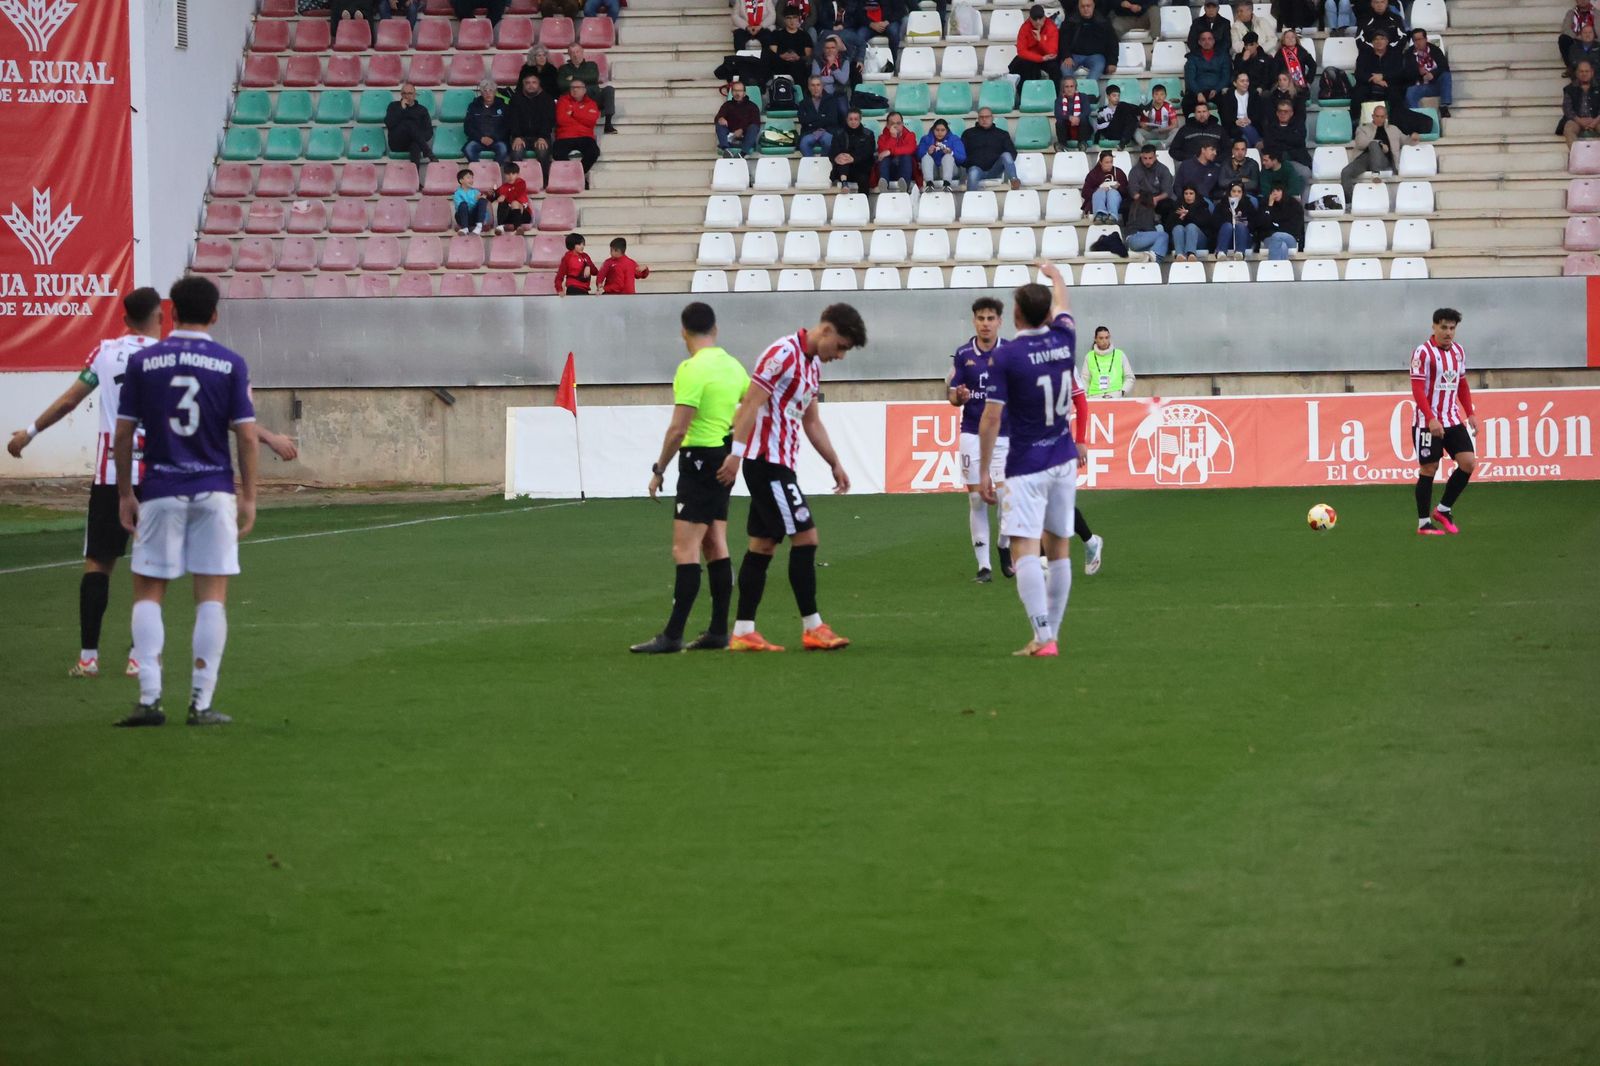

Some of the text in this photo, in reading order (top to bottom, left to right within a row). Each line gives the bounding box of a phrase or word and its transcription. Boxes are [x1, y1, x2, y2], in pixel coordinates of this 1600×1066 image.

[29, 60, 115, 84] RURAL
[0, 88, 88, 104] E ZAMORA
[34, 273, 118, 297] RURAL
[22, 302, 93, 316] ZAMORA
[142, 352, 232, 374] AGUS MORENO
[169, 375, 201, 437] 3
[1036, 370, 1072, 426] 14
[1305, 400, 1370, 463] La
[1421, 431, 1432, 447] 19
[1327, 465, 1346, 481] El
[1478, 462, 1561, 478] Zamora
[787, 483, 802, 506] 3
